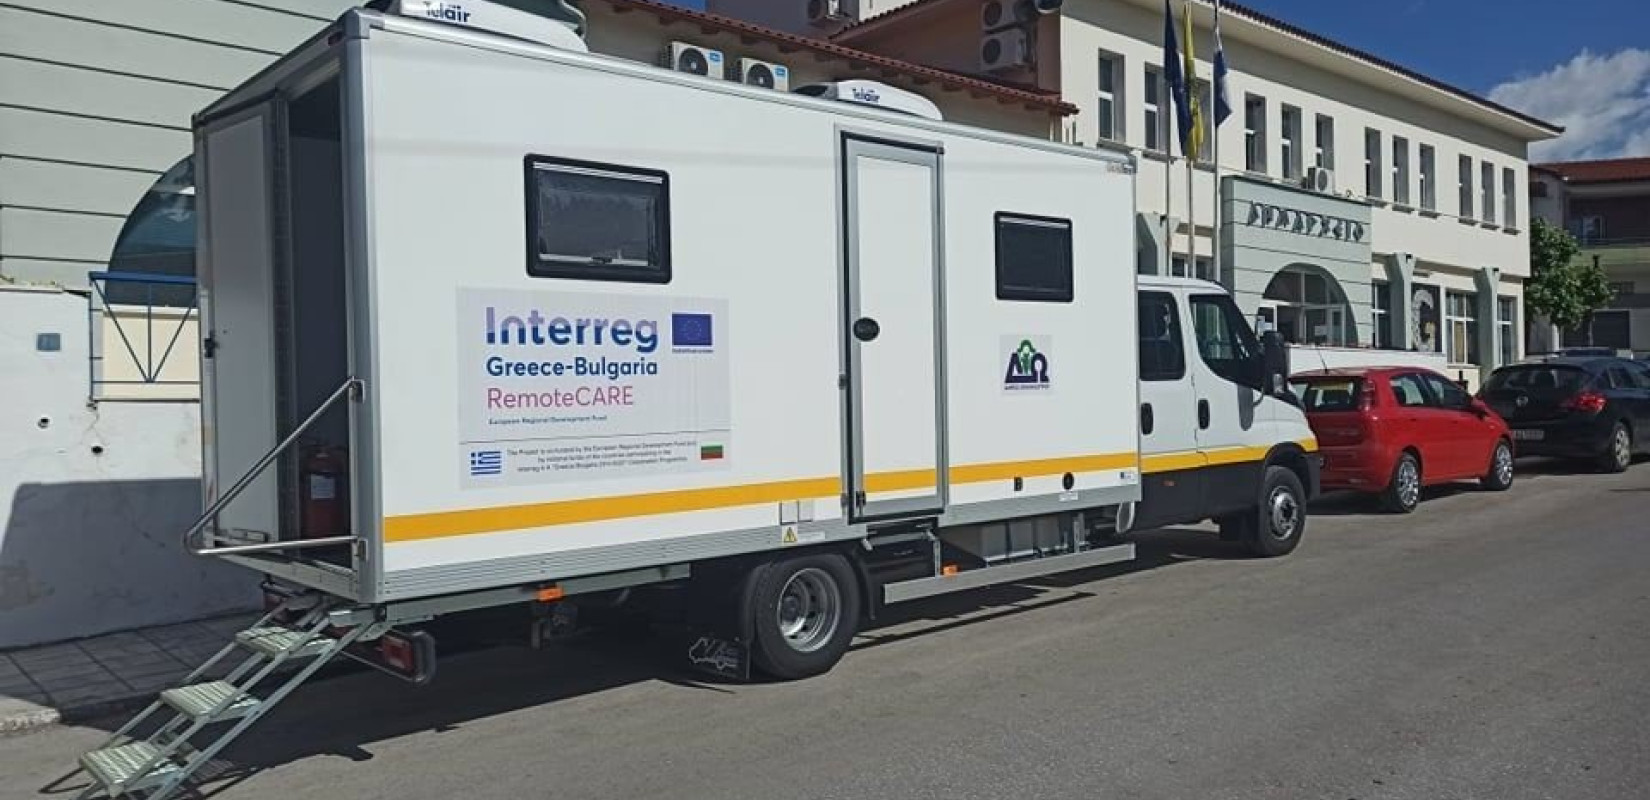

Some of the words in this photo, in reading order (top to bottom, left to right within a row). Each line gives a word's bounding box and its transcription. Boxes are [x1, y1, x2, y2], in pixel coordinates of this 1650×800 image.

[486, 307, 658, 352] Interreg
[486, 356, 658, 380] Greece-Bulgaria
[487, 385, 634, 409] RemoteCARE
